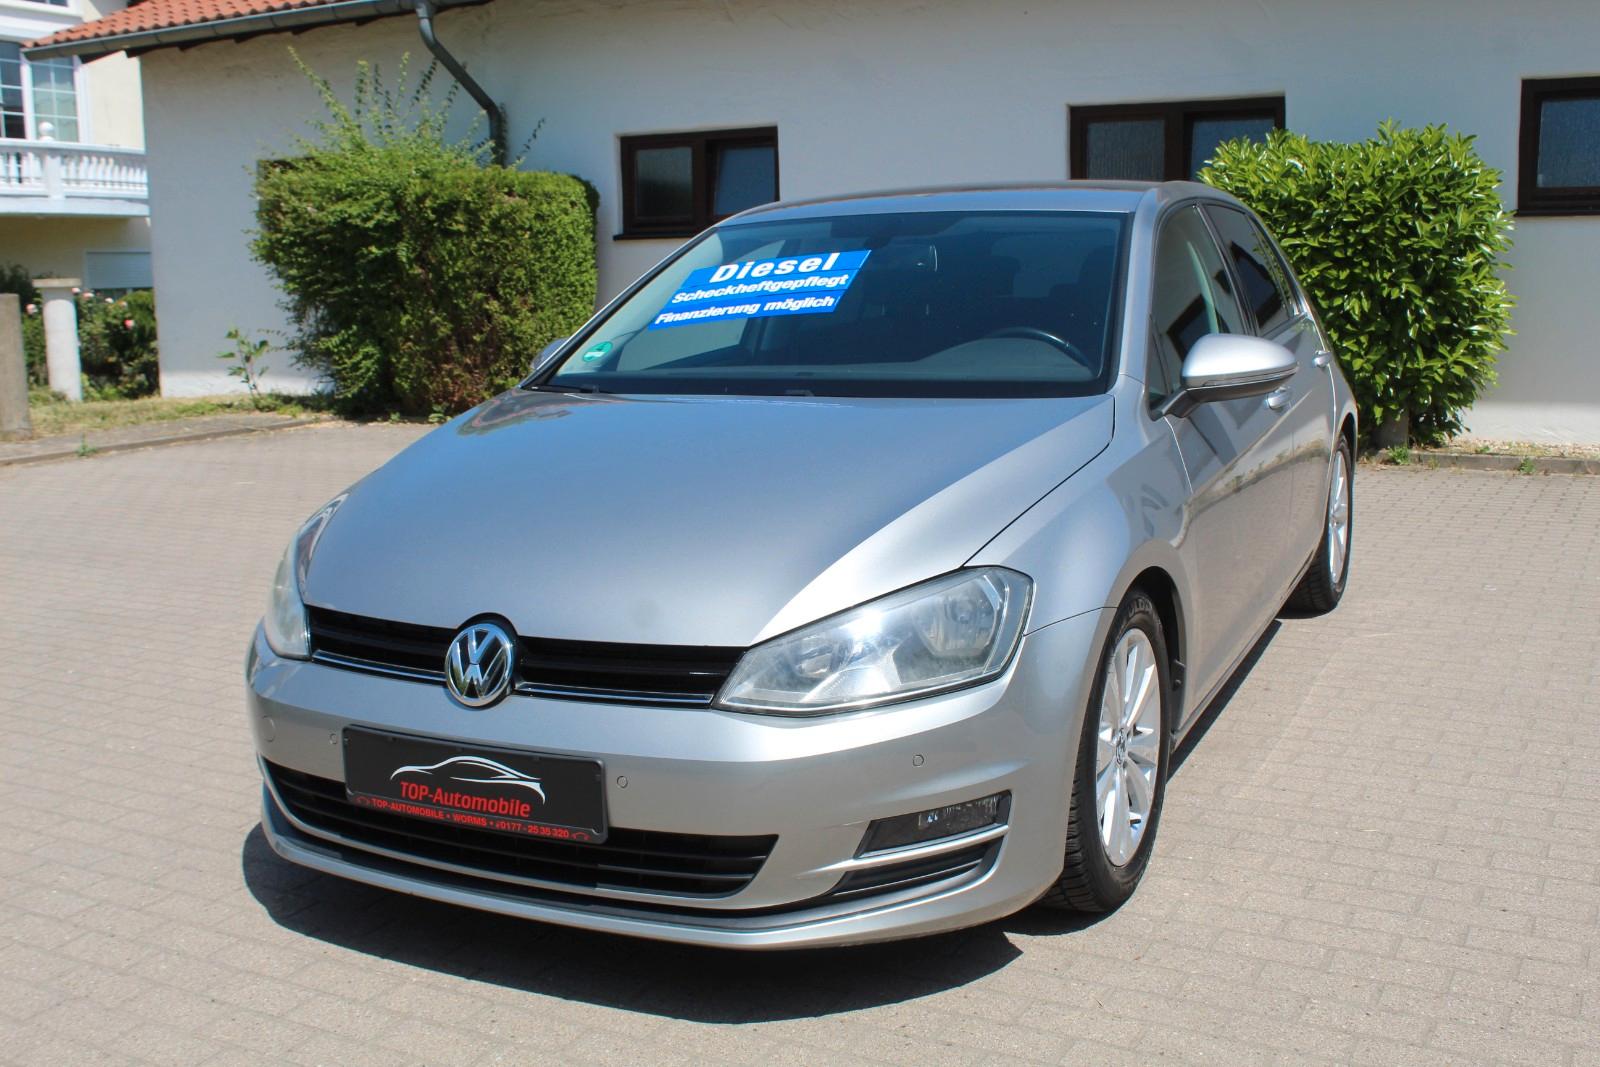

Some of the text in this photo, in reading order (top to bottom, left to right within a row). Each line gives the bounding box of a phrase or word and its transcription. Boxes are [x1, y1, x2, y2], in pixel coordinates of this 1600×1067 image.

[709, 252, 840, 283] Diesel
[671, 274, 849, 304] Scheckheftgepflegt
[654, 296, 835, 325] Finanzierung möglich
[371, 798, 445, 820] TOP-AUTOMOBILE
[452, 813, 487, 827] WORMS
[400, 781, 531, 818] TOP-Automobile
